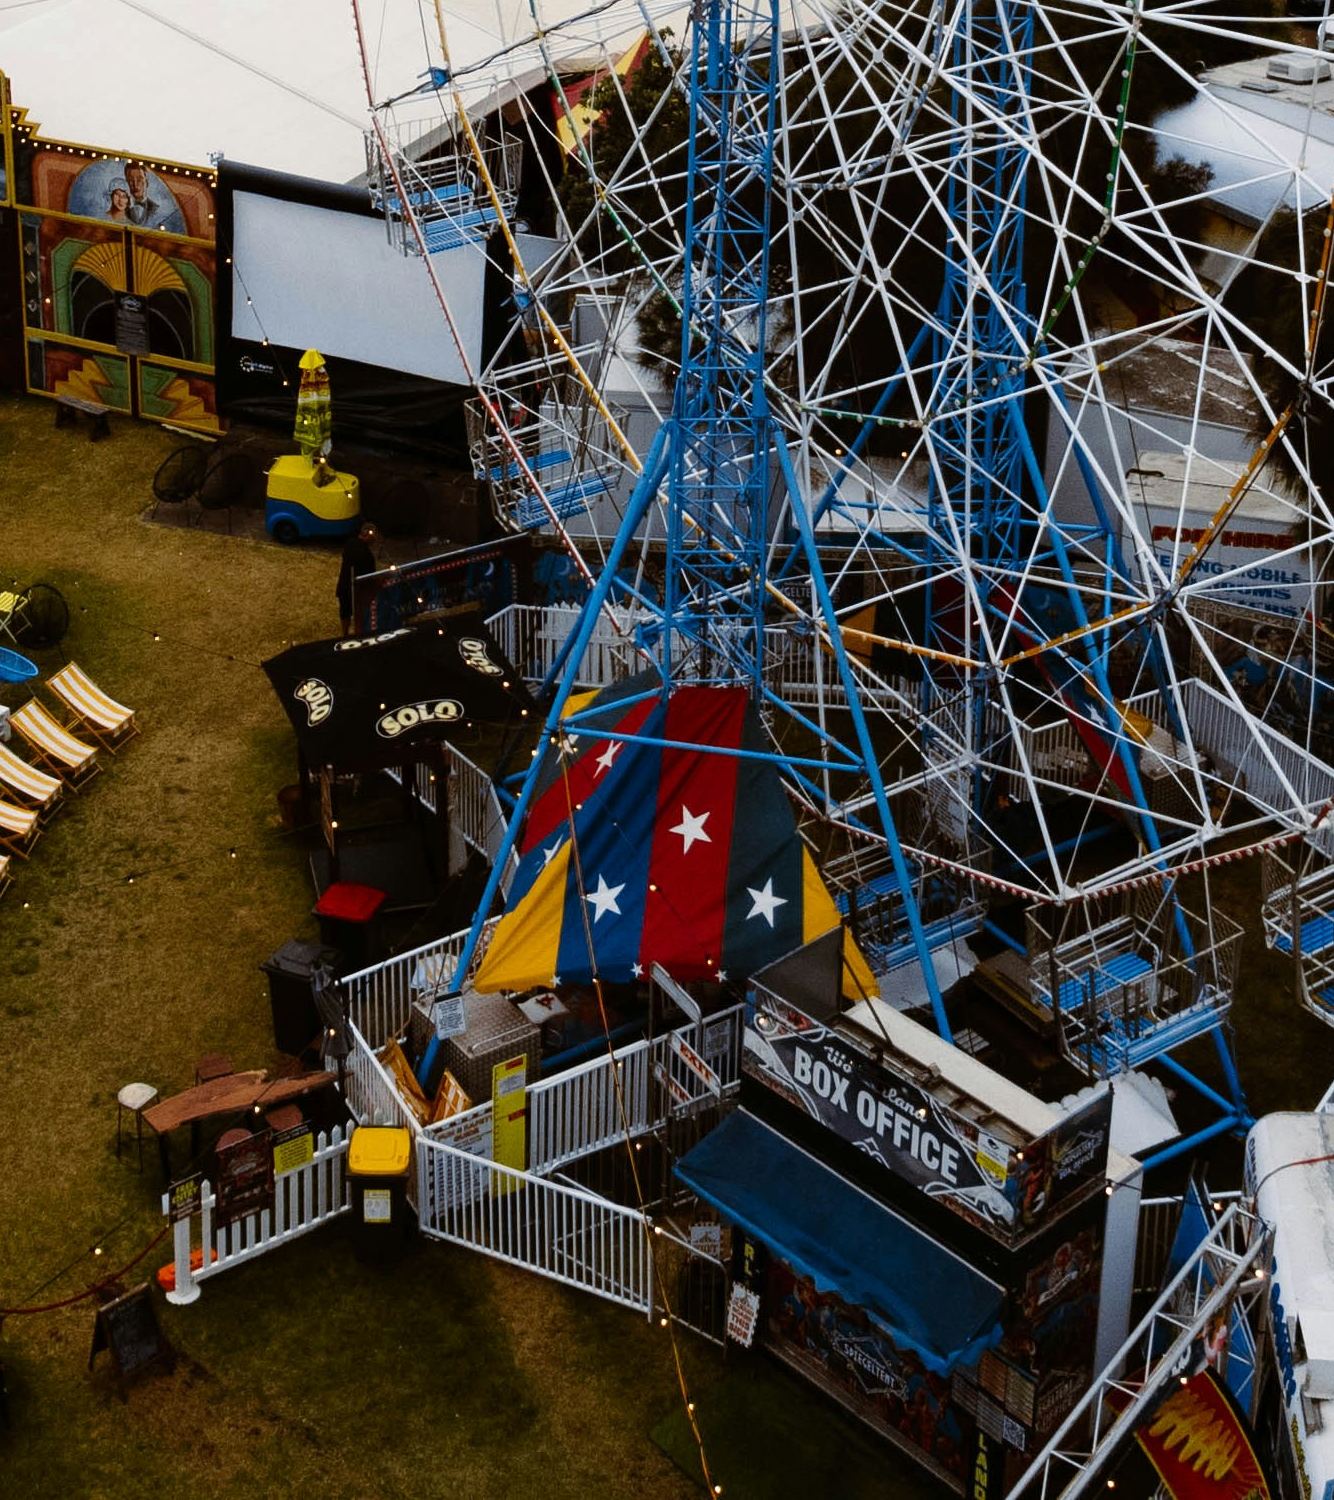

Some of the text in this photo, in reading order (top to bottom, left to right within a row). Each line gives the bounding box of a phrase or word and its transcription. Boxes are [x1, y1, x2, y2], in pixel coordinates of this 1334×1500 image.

[1221, 531, 1294, 550] HIRE
[462, 640, 502, 675] SOLO
[297, 680, 331, 723] SOLO
[380, 701, 458, 736] SOLO
[794, 1046, 850, 1113] BOX
[856, 1090, 960, 1184] OFFICE
